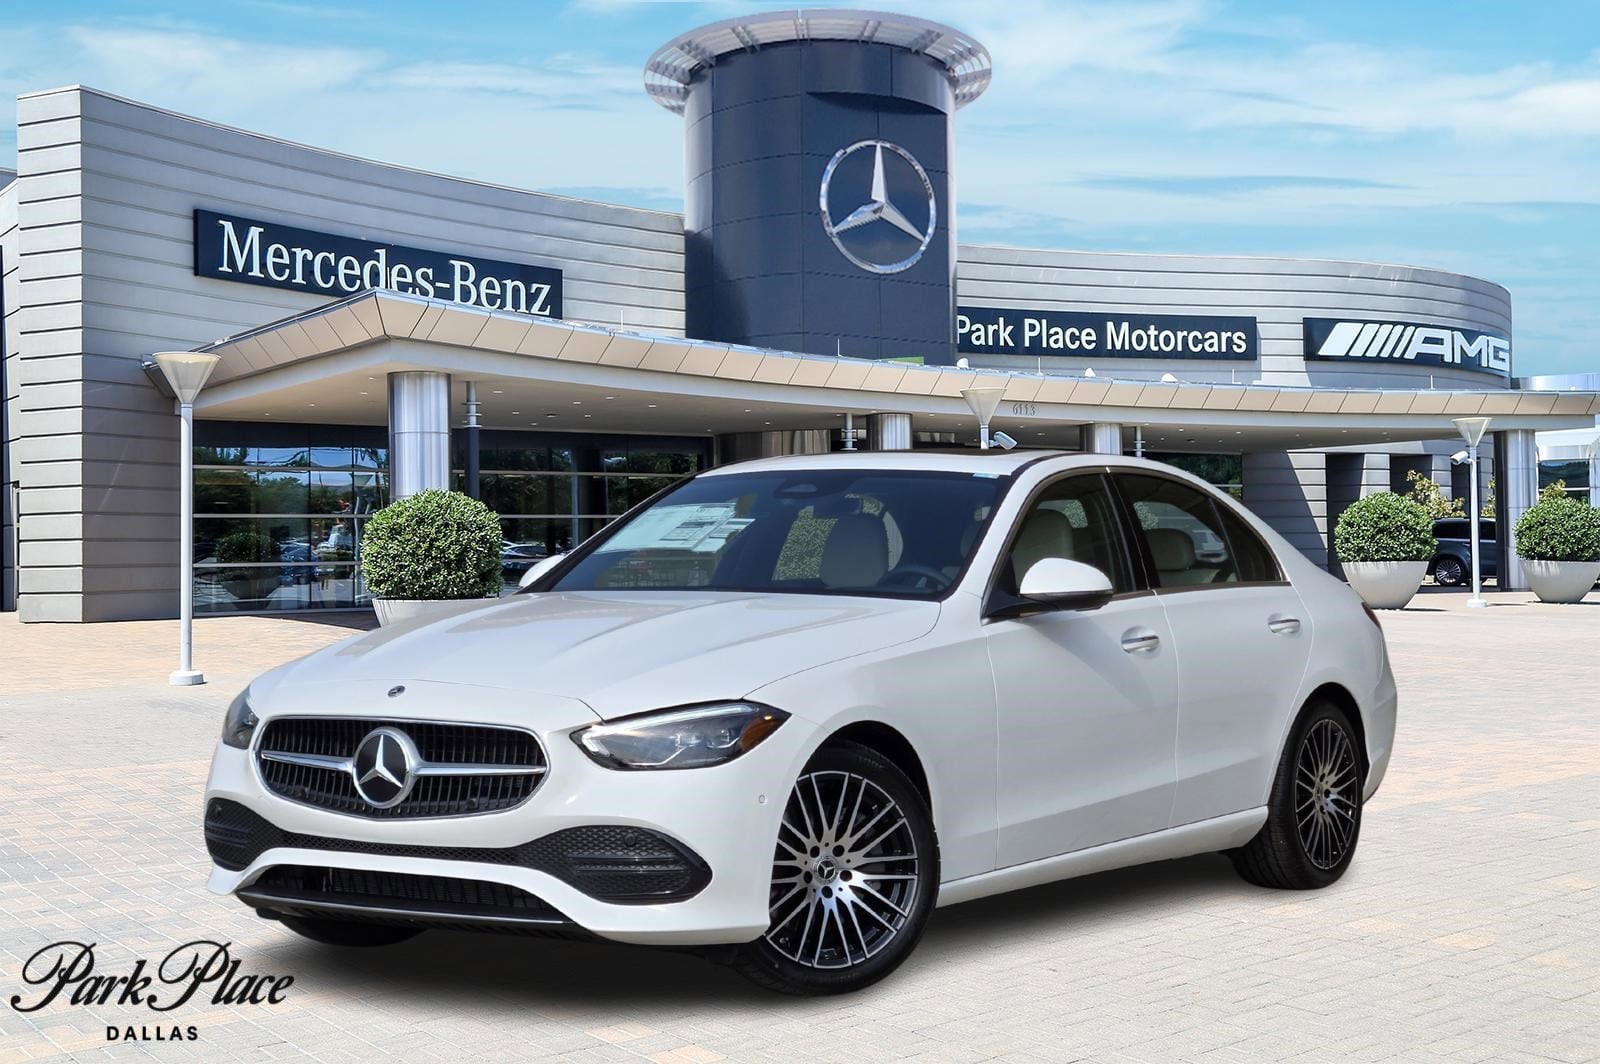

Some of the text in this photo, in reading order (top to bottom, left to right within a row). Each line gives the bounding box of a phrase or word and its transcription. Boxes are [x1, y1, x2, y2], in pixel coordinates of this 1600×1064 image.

[218, 220, 552, 315] Mercedes-Benz
[957, 314, 1247, 353] Park Place Motorcars
[1403, 327, 1509, 371] AMG
